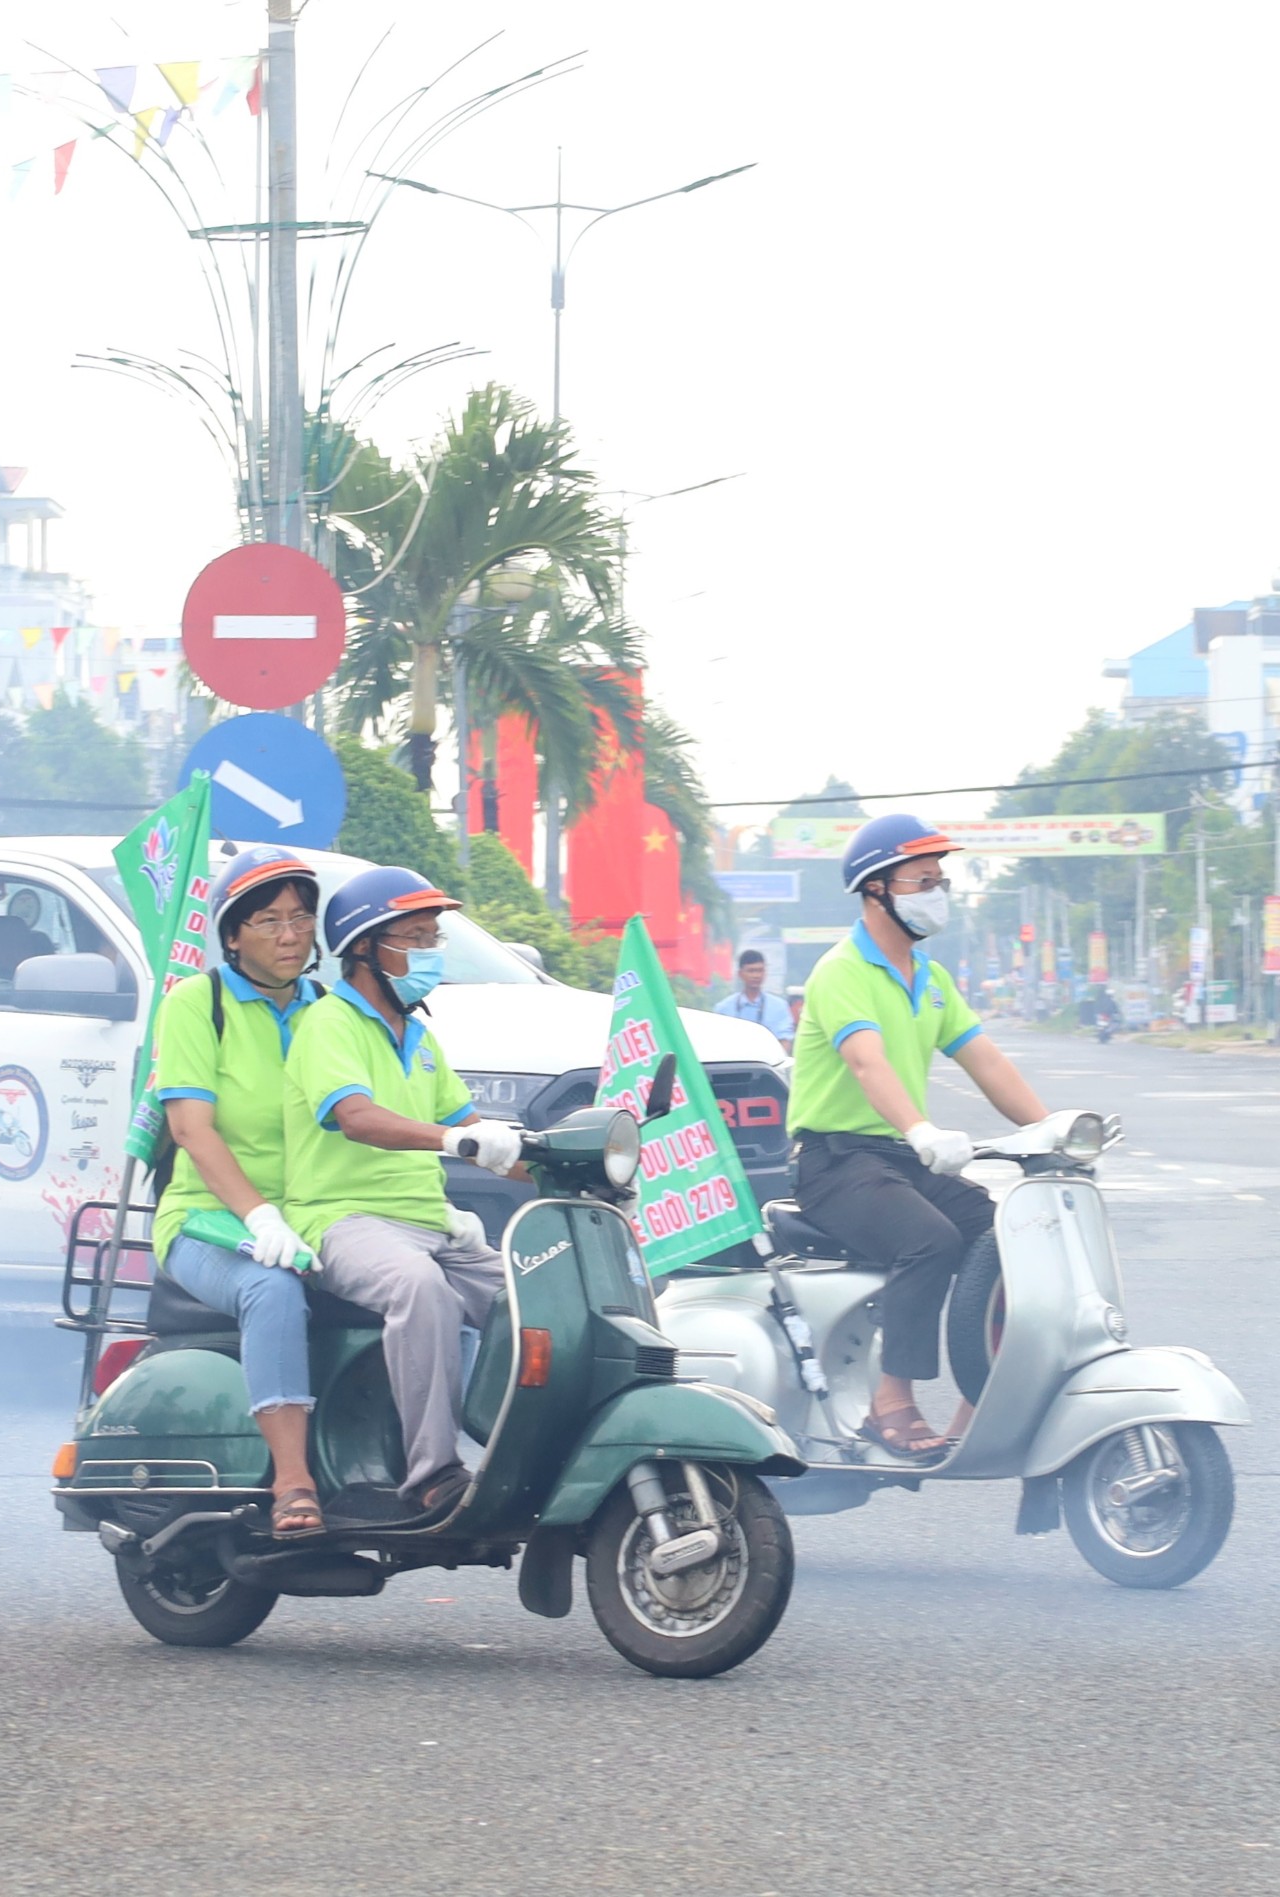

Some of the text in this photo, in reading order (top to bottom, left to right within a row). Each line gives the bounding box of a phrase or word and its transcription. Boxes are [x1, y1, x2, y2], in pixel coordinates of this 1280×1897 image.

[614, 1018, 658, 1066] LIỆT
[665, 1119, 717, 1170] LỊCH
[688, 1176, 737, 1222] 27/9
